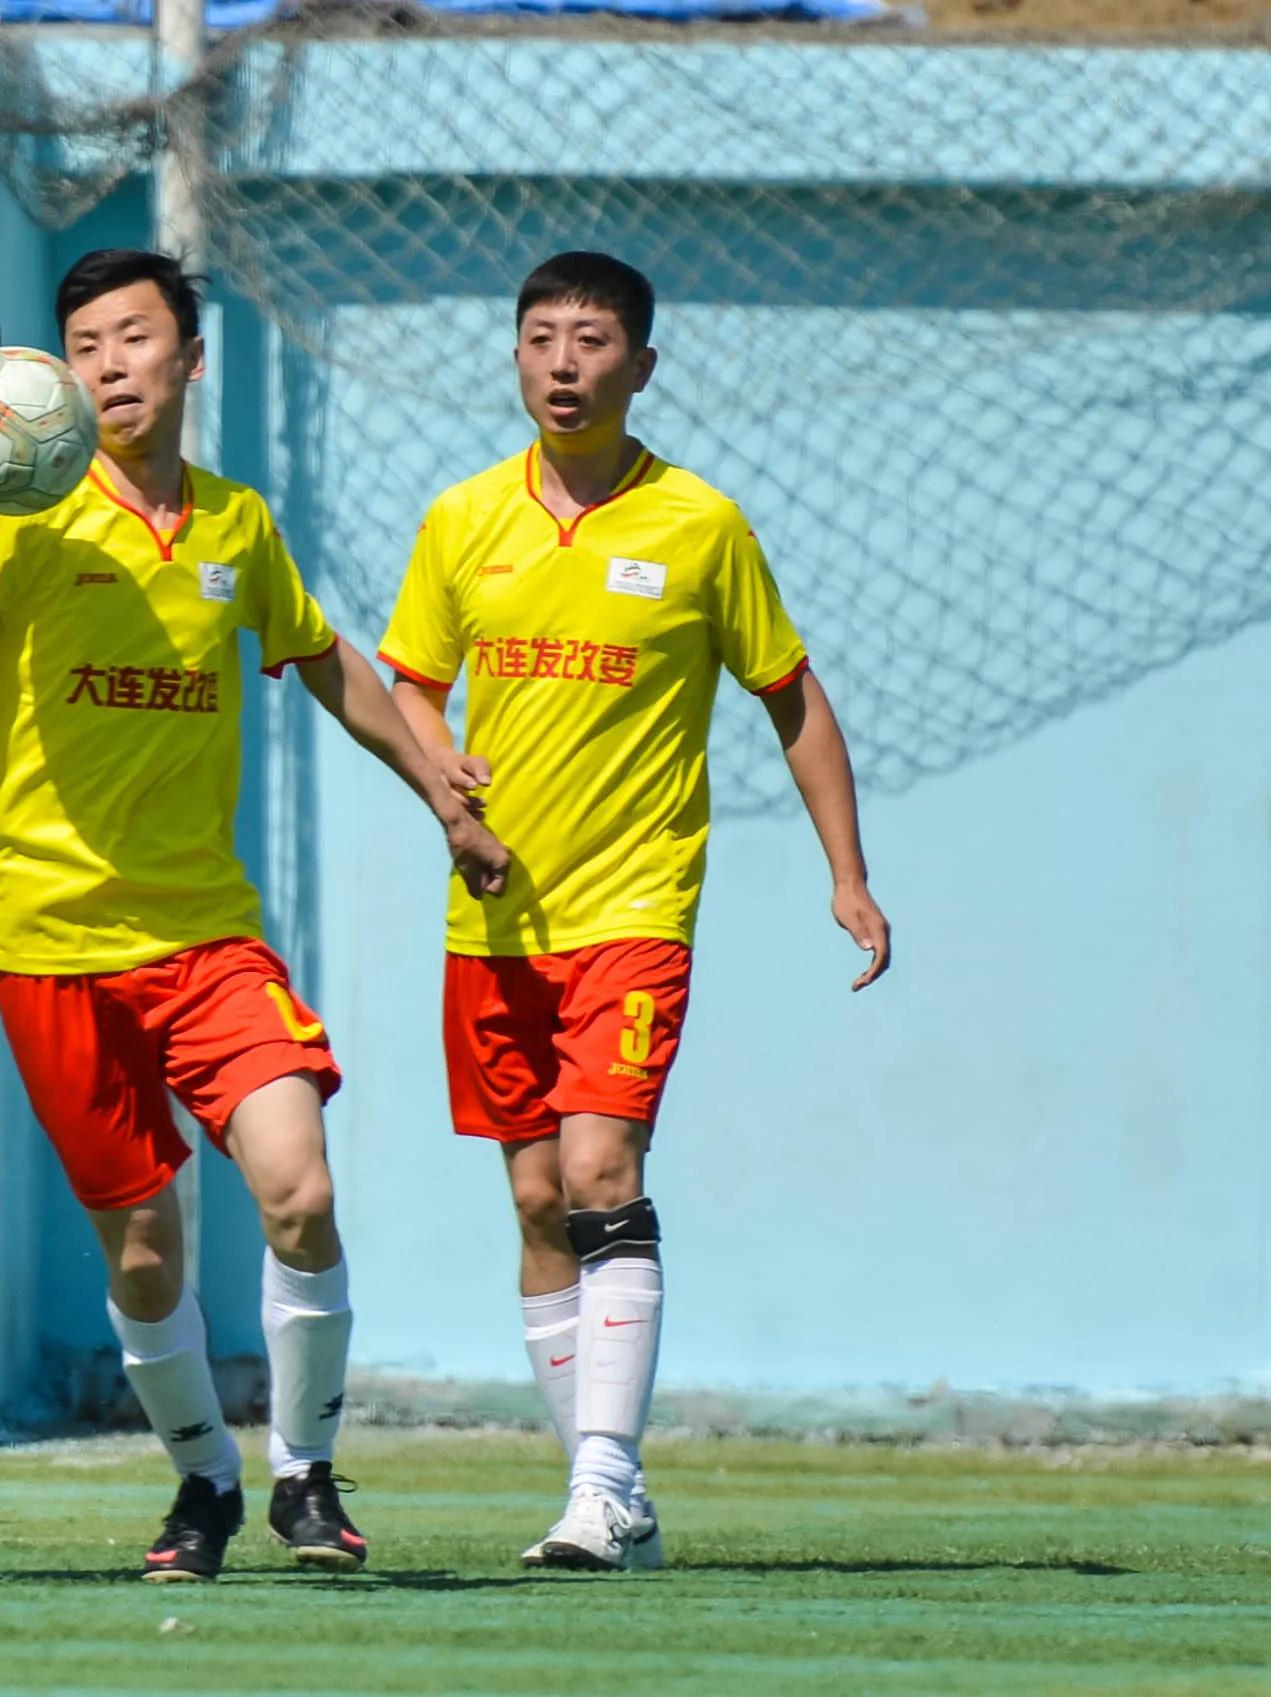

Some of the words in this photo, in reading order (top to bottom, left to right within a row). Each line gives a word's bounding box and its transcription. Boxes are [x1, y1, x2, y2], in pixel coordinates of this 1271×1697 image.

[473, 636, 639, 687] 大连发改委
[620, 991, 654, 1063] 3
